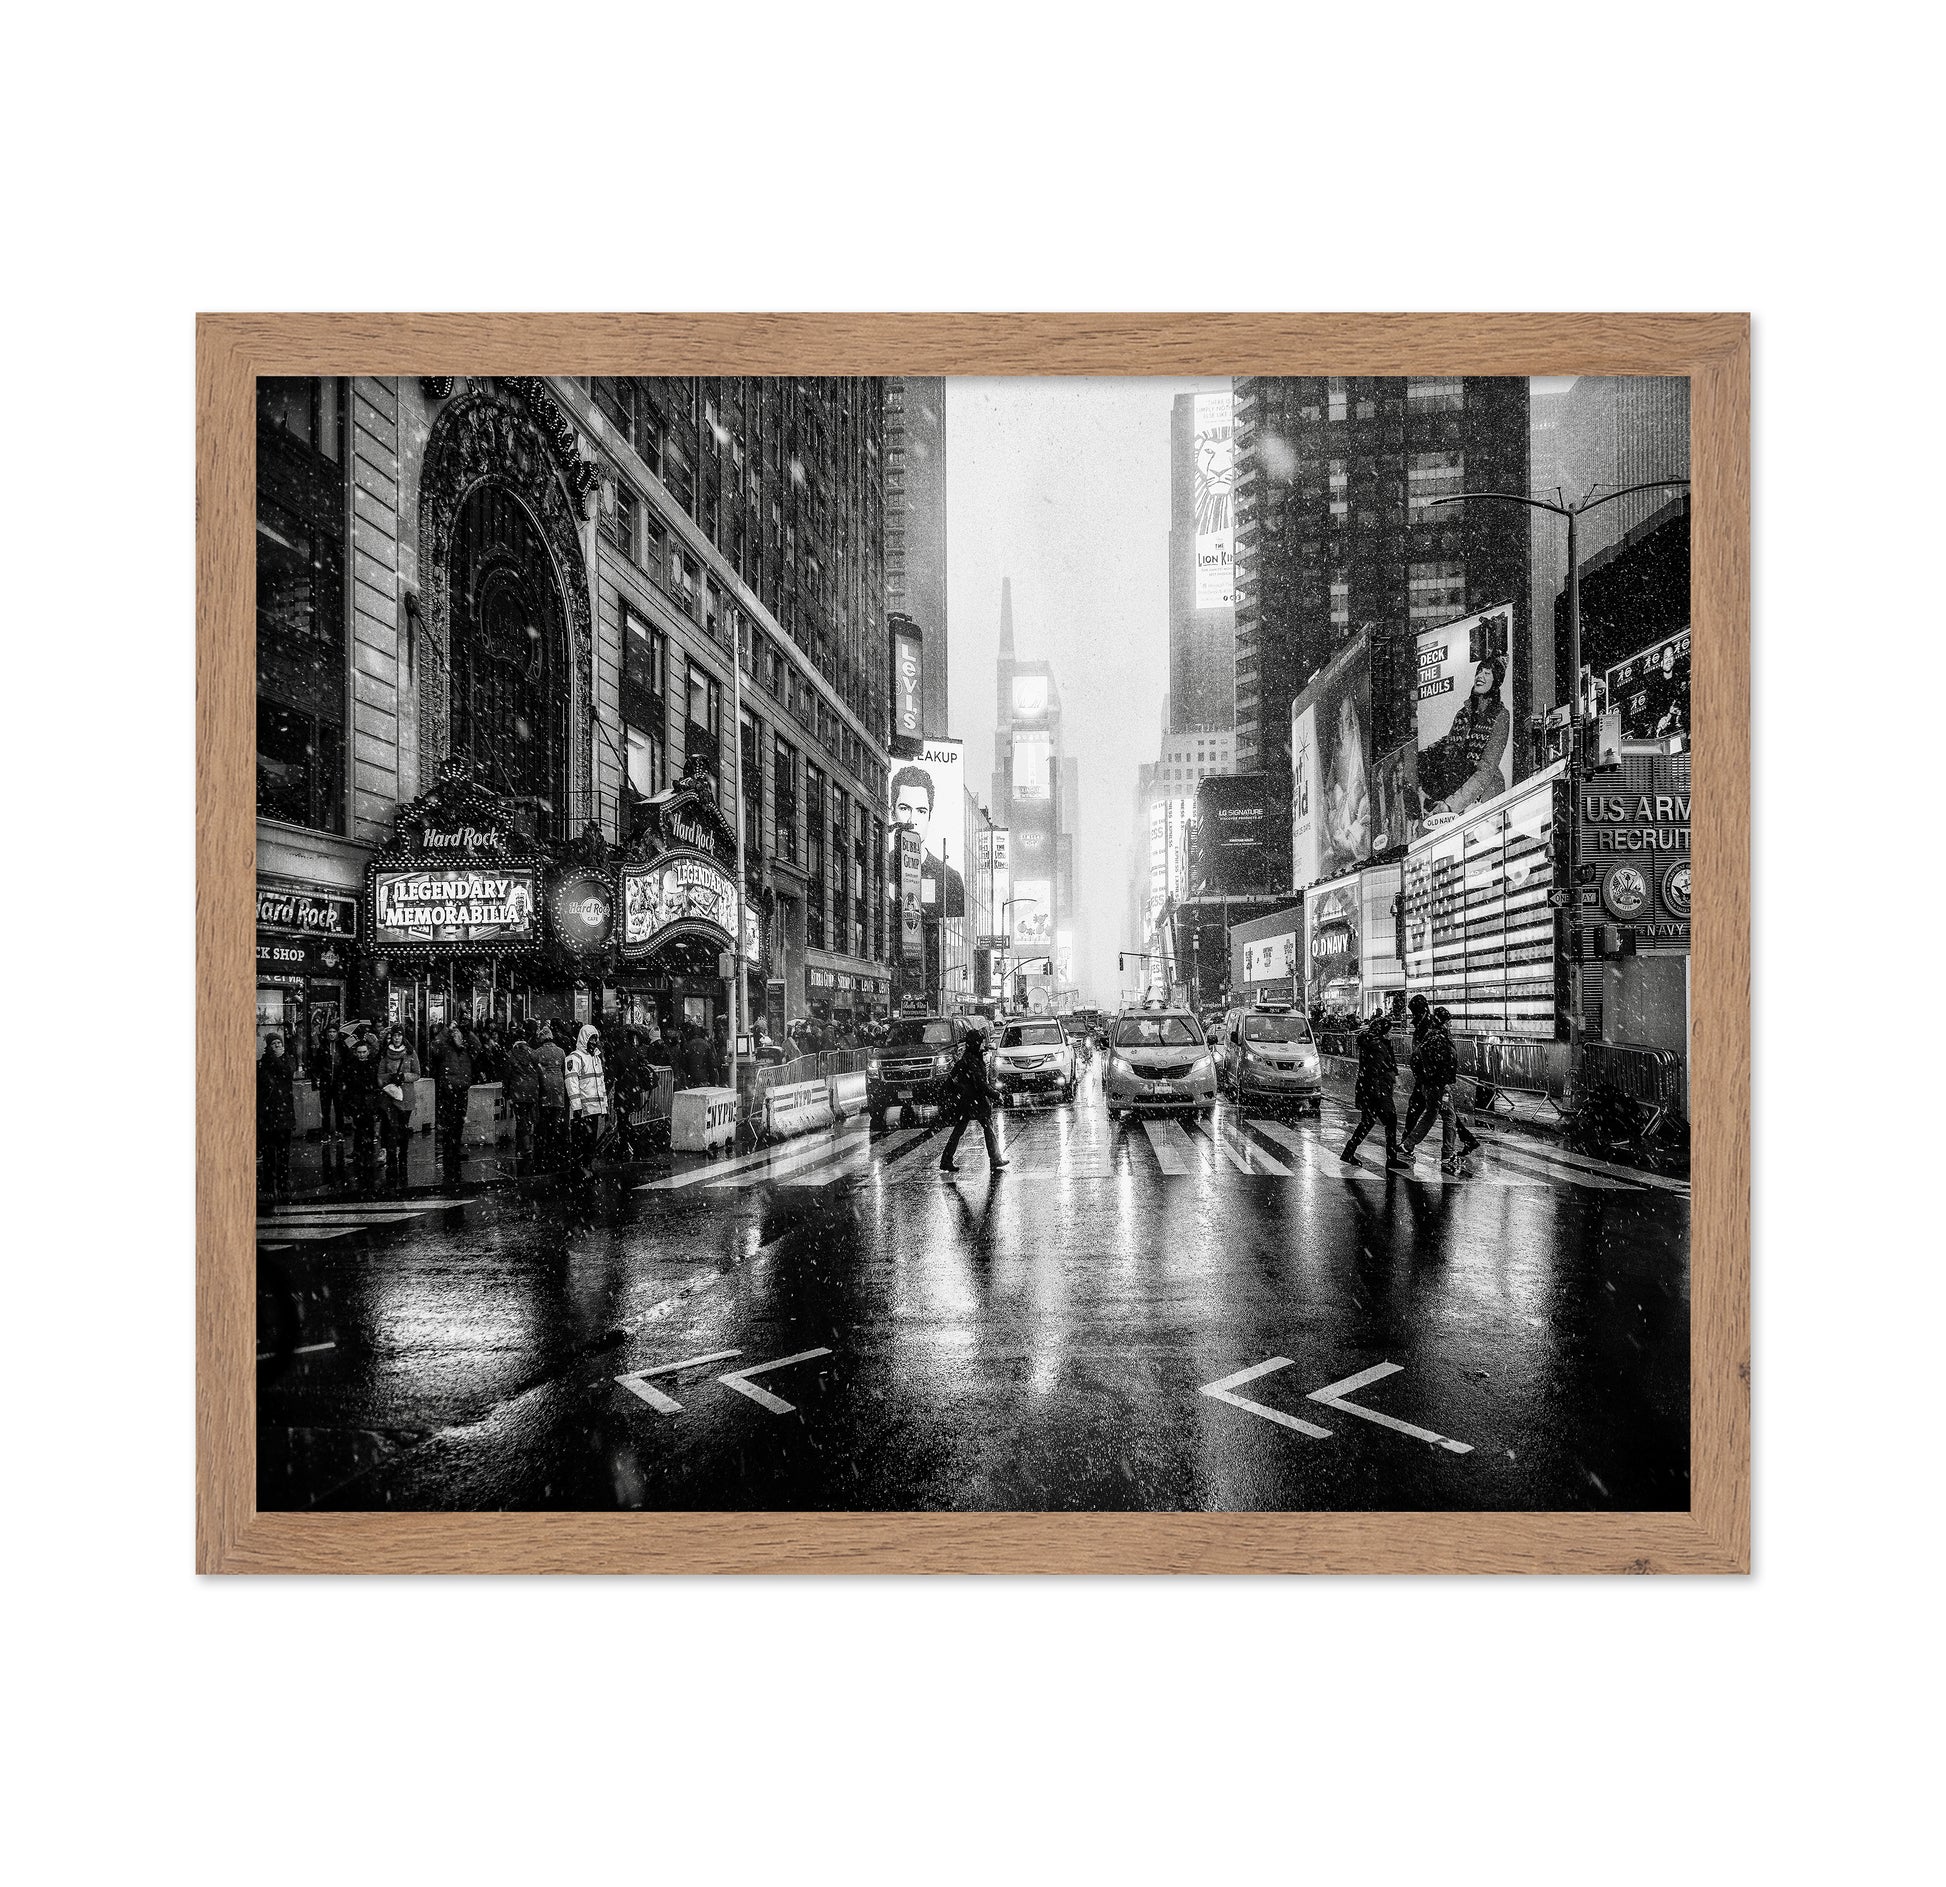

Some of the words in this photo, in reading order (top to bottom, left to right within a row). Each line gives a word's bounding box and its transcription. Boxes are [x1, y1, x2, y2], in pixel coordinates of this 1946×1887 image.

[1420, 648, 1445, 667] DECK
[1420, 667, 1438, 682] THE
[1420, 680, 1451, 699] HAULS
[1228, 808, 1264, 816] SIGNATURE
[1427, 819, 1439, 827] OLD
[1440, 815, 1456, 825] NAVY
[423, 827, 462, 847] Hard
[463, 827, 500, 849] Rock
[673, 812, 696, 843] Hard
[695, 824, 715, 856] Rock
[397, 879, 509, 901] LEGENDARY
[1556, 893, 1570, 903] ONE
[297, 898, 338, 932] Rock
[385, 905, 520, 926] MEMORABILIA
[569, 901, 593, 914] Hard
[593, 902, 611, 917] Rock
[1647, 924, 1684, 936] NAVY
[273, 947, 305, 961] SHOP
[1312, 938, 1327, 957] OD
[1327, 933, 1349, 954] NAVY
[710, 1101, 734, 1128] NYPD
